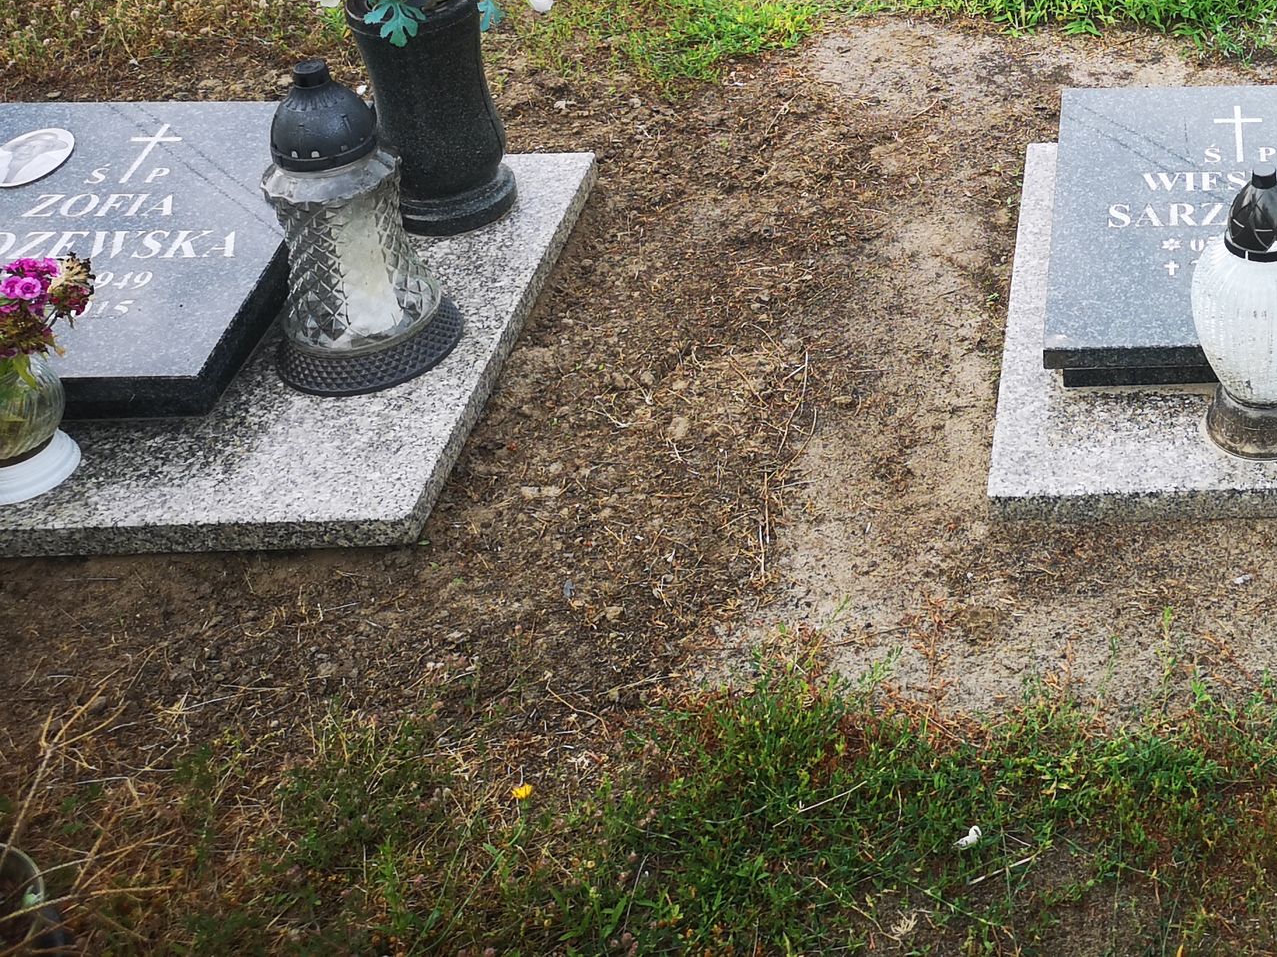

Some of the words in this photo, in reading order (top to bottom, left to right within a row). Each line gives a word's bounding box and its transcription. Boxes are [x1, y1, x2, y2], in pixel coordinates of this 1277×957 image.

[1204, 144, 1221, 163] Ś
[1259, 147, 1276, 162] P
[83, 163, 110, 184] Ś
[144, 167, 170, 184] P
[21, 193, 174, 217] ZOFIA
[0, 230, 236, 259] DZEWSKA
